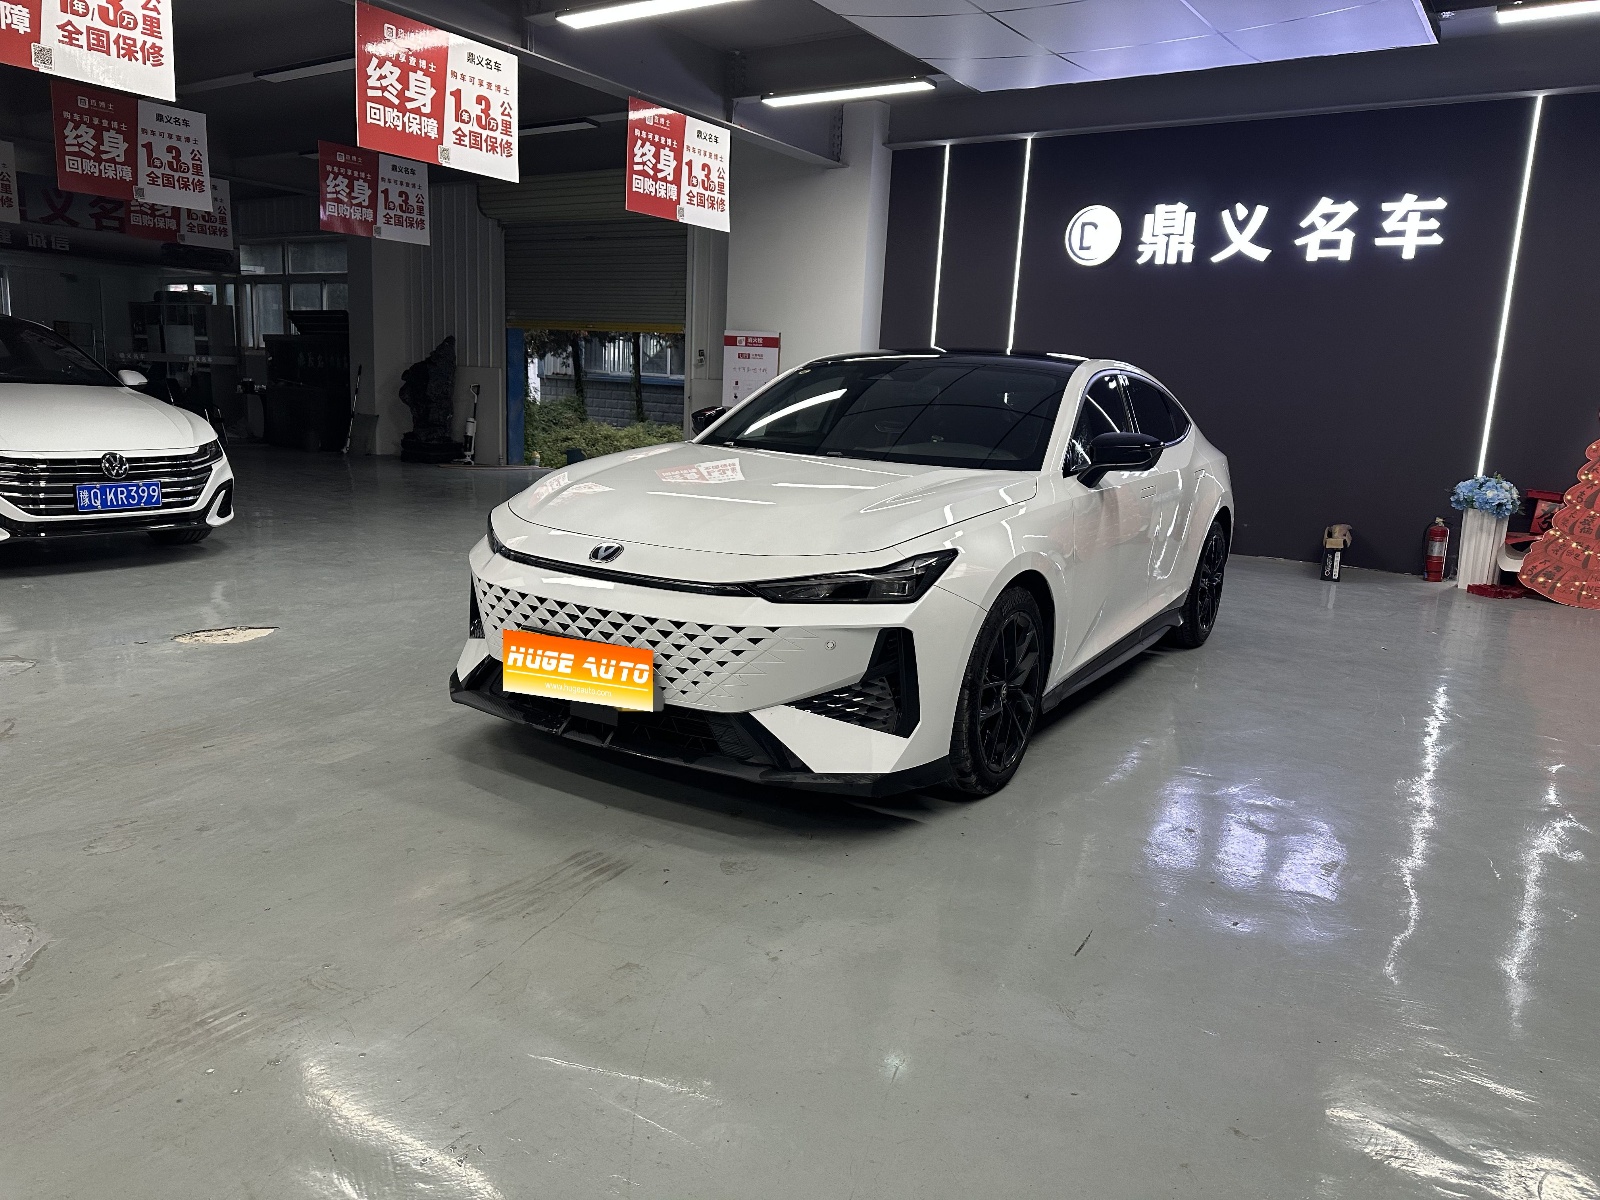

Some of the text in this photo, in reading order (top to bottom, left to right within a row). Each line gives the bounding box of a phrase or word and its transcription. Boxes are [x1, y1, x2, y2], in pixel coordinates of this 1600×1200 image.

[56, 20, 164, 67] 全国保修
[467, 51, 502, 72] 鼎义名车
[366, 57, 436, 113] 终身
[155, 113, 190, 127] 鼎义名车
[366, 102, 439, 140] 回购保障
[64, 121, 129, 162] 终身
[452, 127, 513, 158] 全国保修
[65, 155, 133, 182] 回购保障
[633, 139, 677, 181] 终身
[146, 171, 205, 193] 全国保修
[326, 173, 372, 206] 终身
[632, 174, 677, 201] 回购保障
[326, 202, 373, 222] 回购保障
[686, 190, 725, 212] 全国保修
[382, 212, 426, 230] 全国保修
[1136, 193, 1448, 265] 鼎义名车
